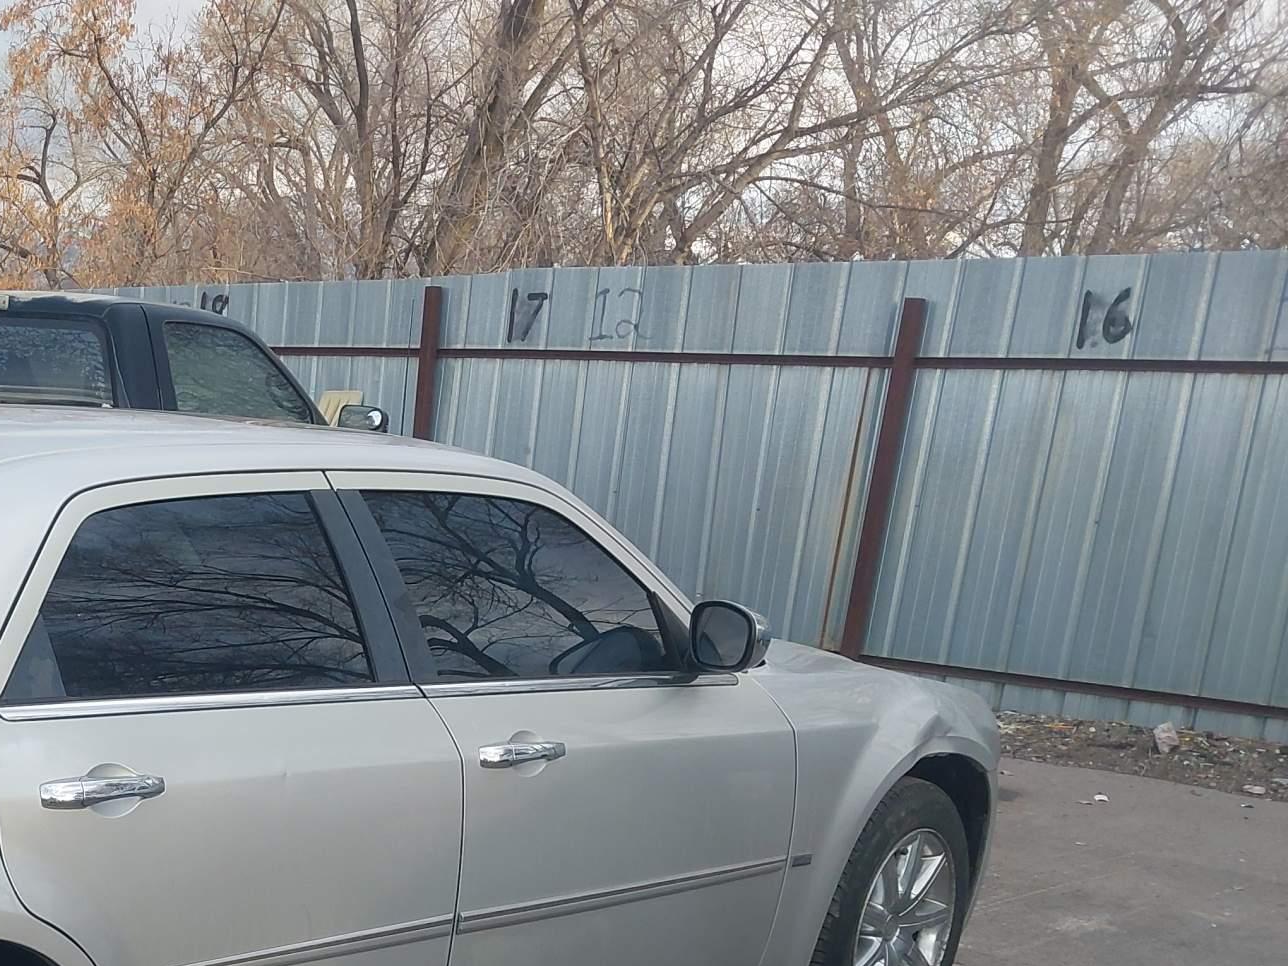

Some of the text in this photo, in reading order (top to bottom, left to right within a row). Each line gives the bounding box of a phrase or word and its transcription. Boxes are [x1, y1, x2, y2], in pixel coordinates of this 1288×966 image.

[507, 288, 548, 343] 17
[588, 288, 652, 340] 12
[1076, 287, 1132, 350] 16
